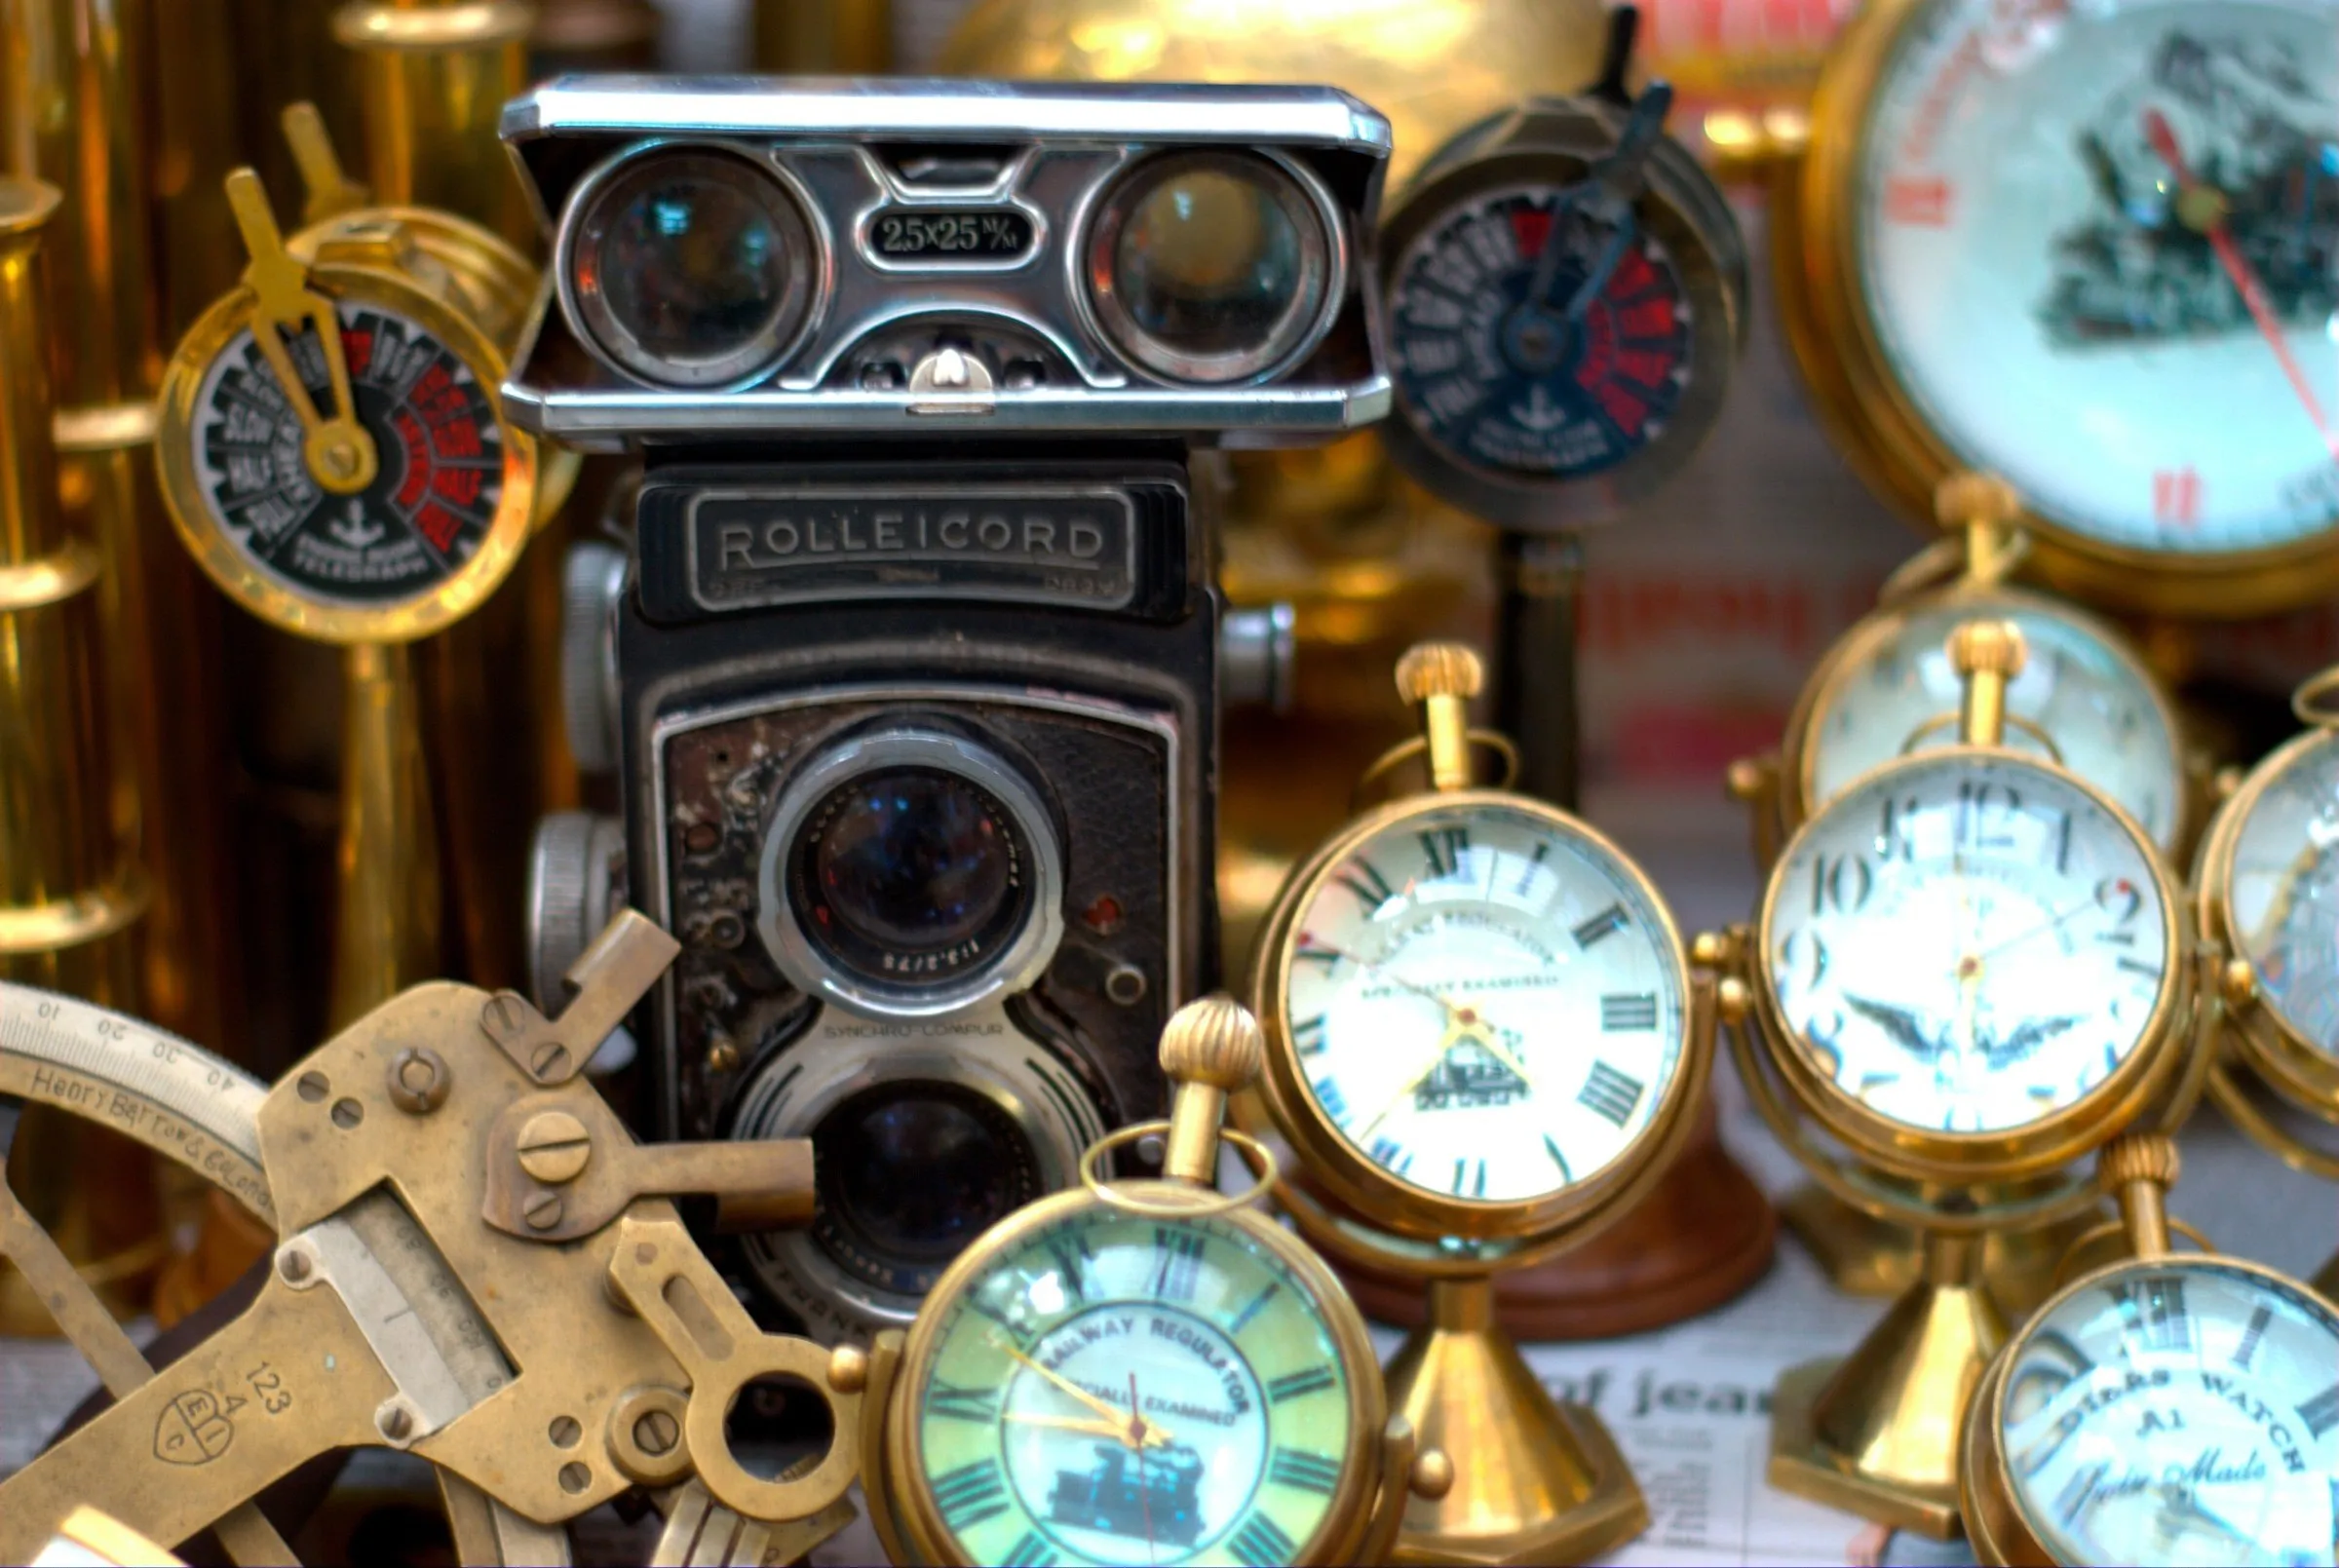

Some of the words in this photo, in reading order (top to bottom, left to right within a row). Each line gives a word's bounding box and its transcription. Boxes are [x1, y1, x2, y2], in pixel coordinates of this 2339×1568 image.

[720, 511, 1104, 572] ROLLEICORD
[246, 1360, 292, 1416] 123
[1143, 1395, 1237, 1429] EXAMINED
[2200, 1370, 2306, 1474] WATCH
